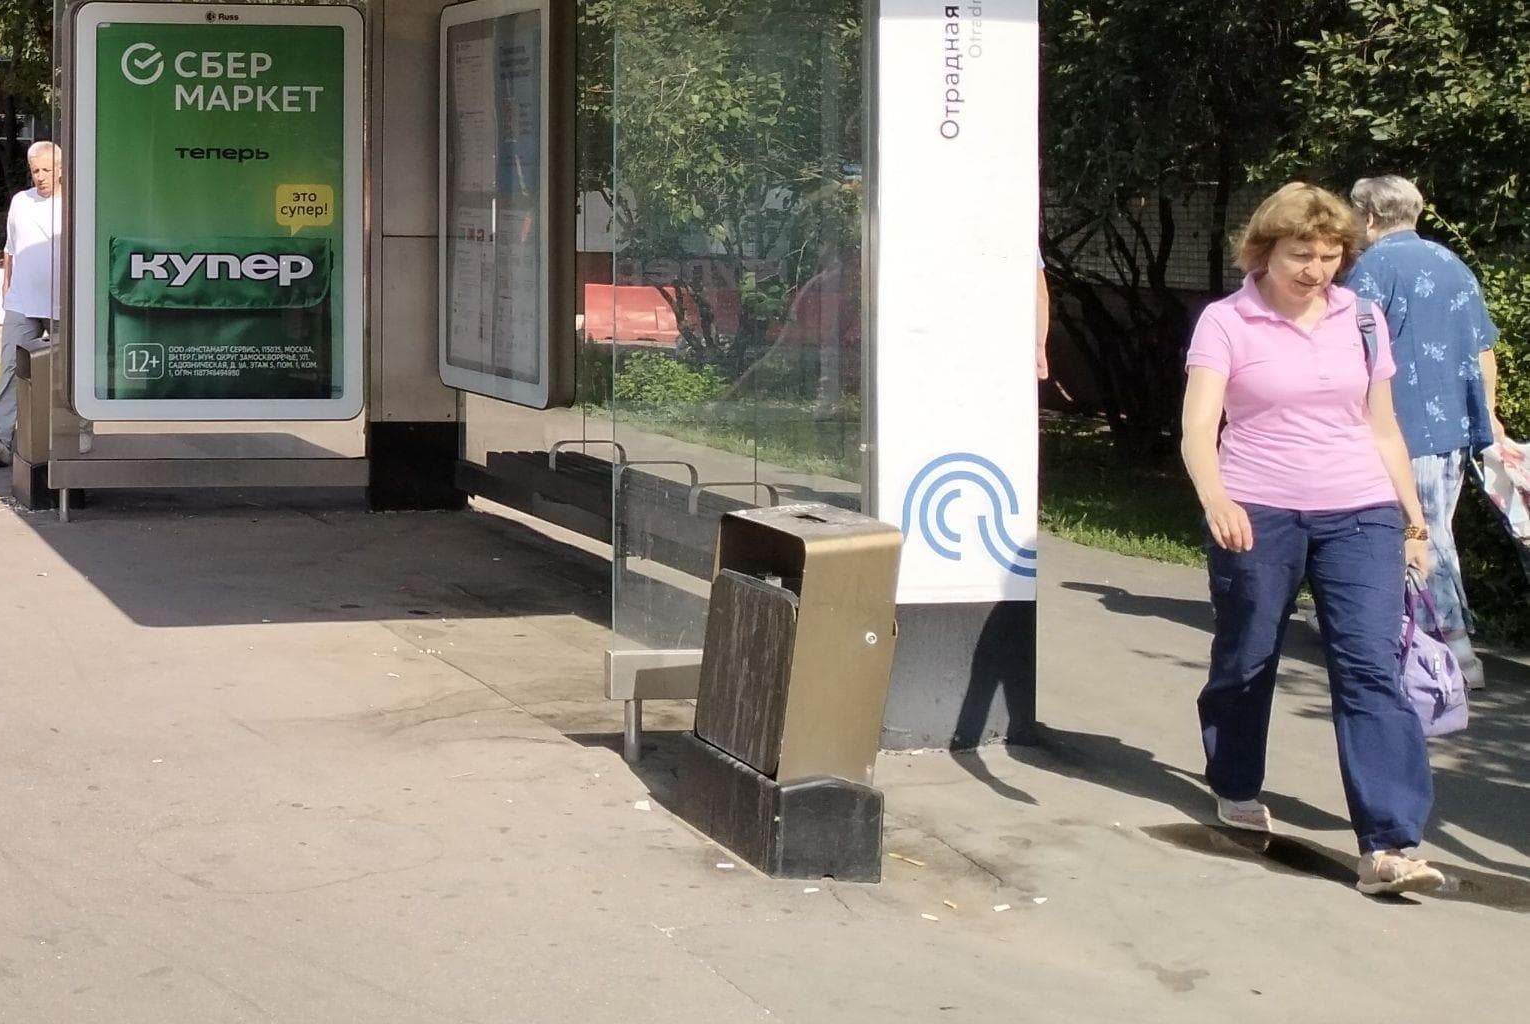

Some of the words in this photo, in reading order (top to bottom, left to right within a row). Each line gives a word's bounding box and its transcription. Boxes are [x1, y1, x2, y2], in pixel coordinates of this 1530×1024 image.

[217, 13, 239, 22] Russ
[174, 50, 273, 79] СБЕР
[940, 5, 965, 140] Отрадная
[174, 84, 325, 113] МАРКЕТ
[174, 146, 271, 163] теперь
[291, 191, 318, 203] это
[280, 202, 329, 218] супер!
[130, 252, 315, 287] купер
[128, 350, 161, 373] 12+
